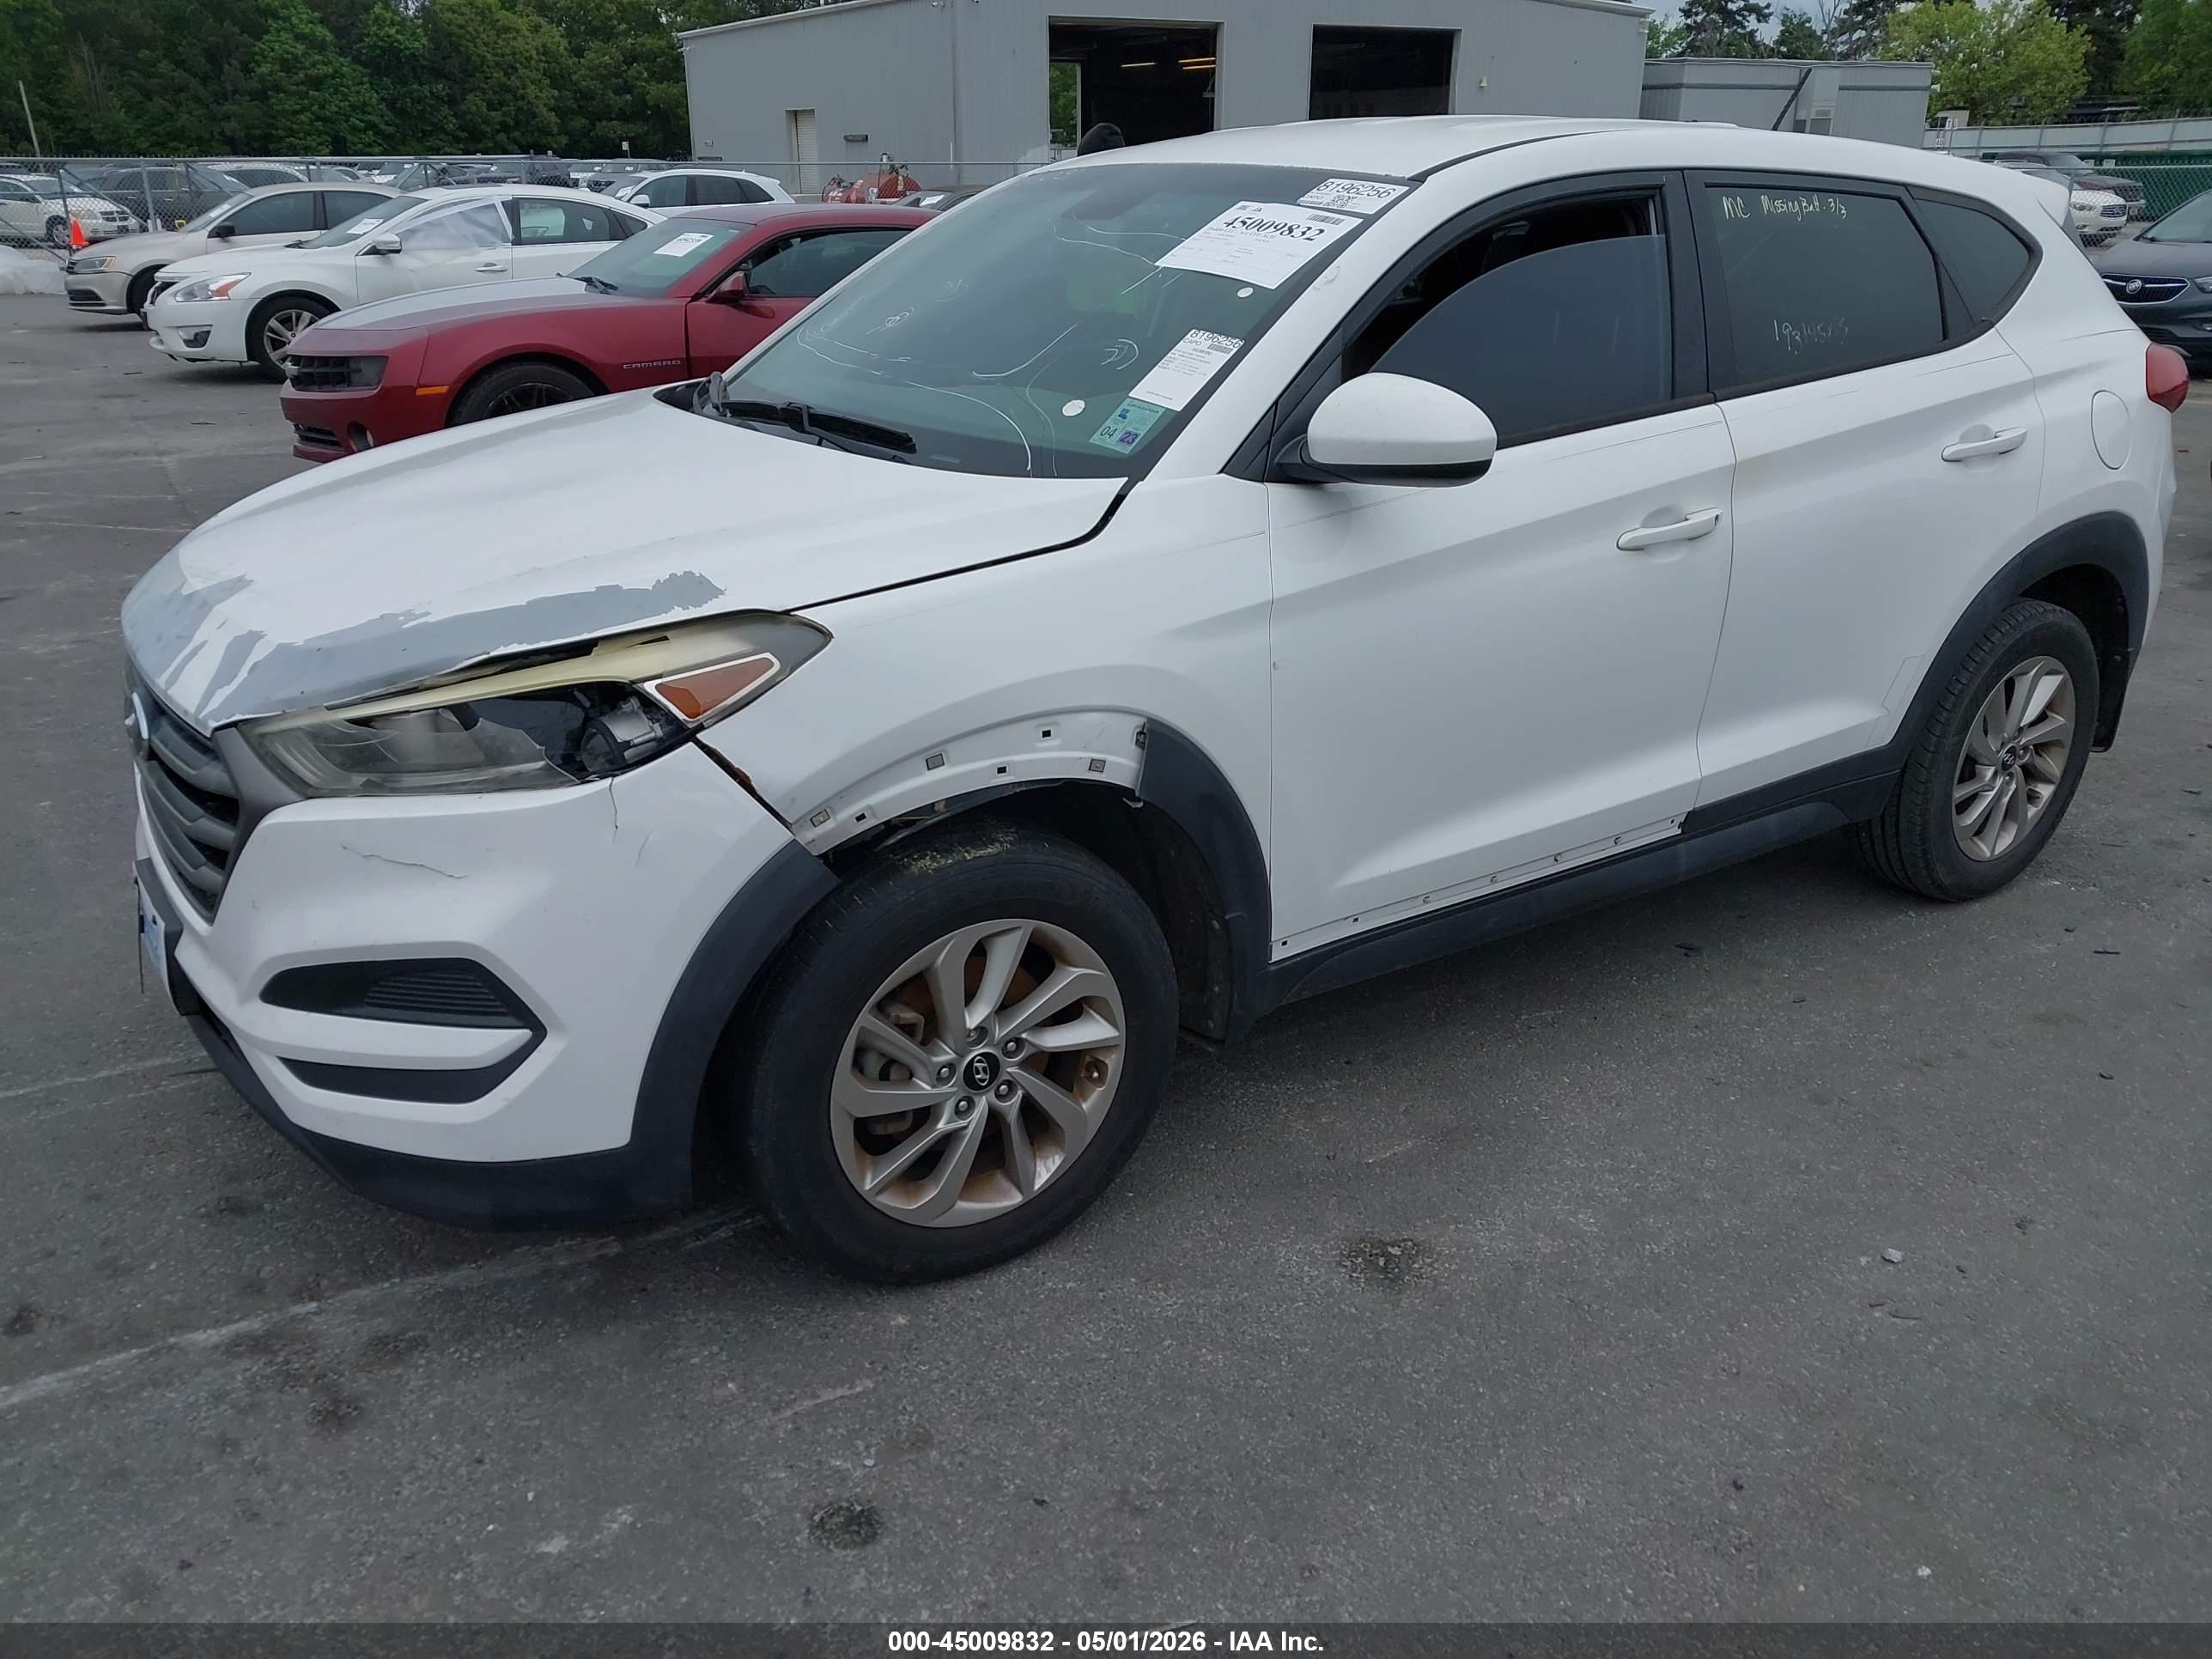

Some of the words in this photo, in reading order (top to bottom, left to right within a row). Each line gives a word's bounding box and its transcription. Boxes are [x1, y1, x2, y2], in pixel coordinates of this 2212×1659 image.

[1317, 181, 1396, 198] 8196256
[1723, 195, 1751, 220] MC
[1223, 216, 1325, 241] 45009832
[1190, 329, 1245, 349] 8196256
[623, 360, 681, 369] CAMARO
[1100, 425, 1117, 439] 04
[1120, 431, 1139, 445] 23
